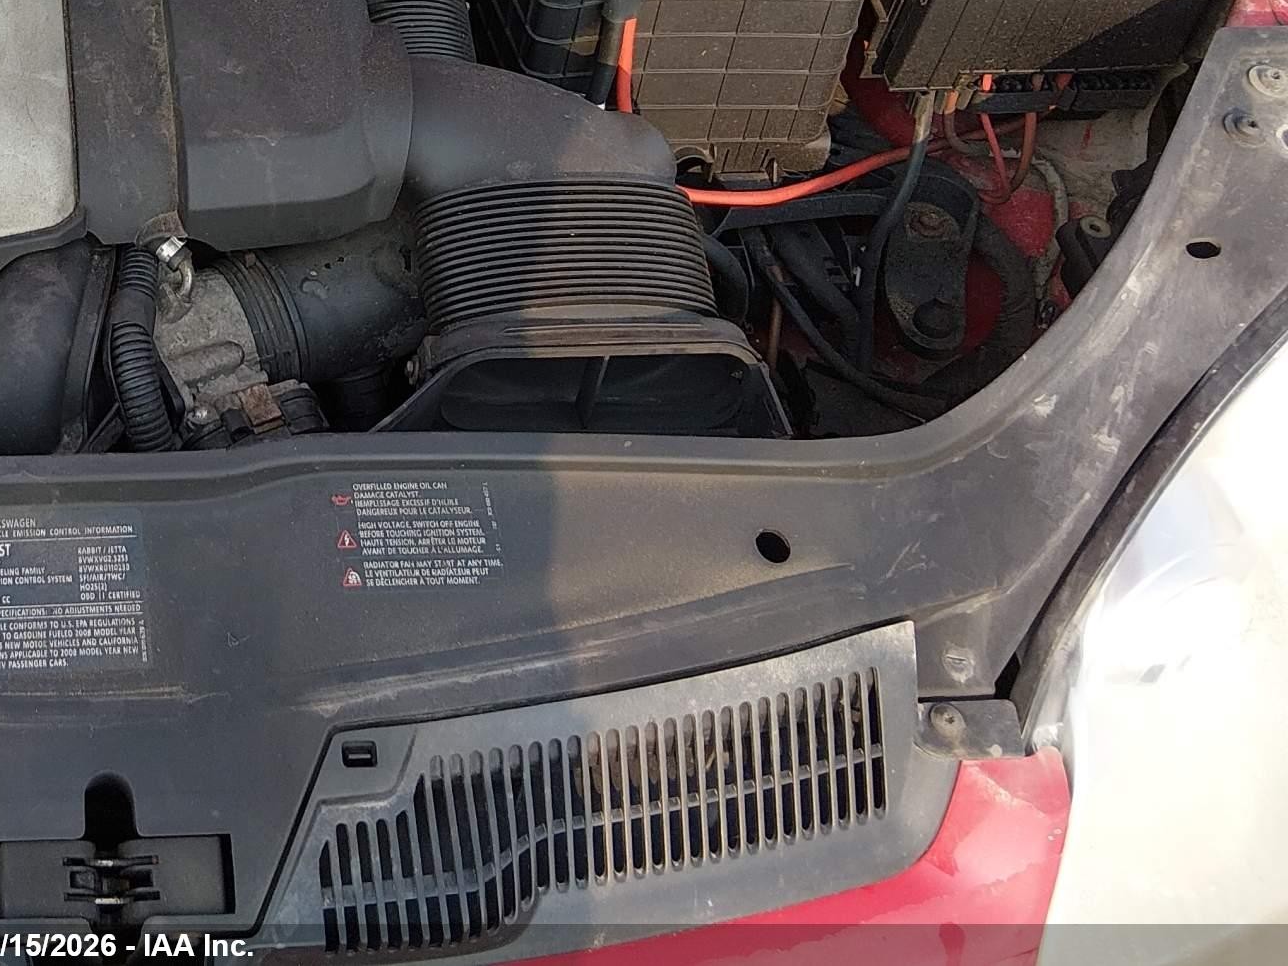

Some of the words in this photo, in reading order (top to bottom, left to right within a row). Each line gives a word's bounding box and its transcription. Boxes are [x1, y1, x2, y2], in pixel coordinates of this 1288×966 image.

[352, 482, 392, 491] OVERFILLED
[393, 482, 419, 490] ENGINE
[419, 481, 432, 490] OIL
[432, 481, 448, 490] CAN
[353, 491, 385, 499] DAMAGE
[385, 490, 422, 498] CATALYST.
[354, 499, 400, 508] REMPLISSAGE
[356, 507, 398, 516] DANGEREUX
[399, 507, 418, 515] POUR
[419, 507, 427, 515] LE
[357, 521, 376, 529] HIGH
[412, 520, 439, 528] SWITCH
[439, 520, 454, 528] OFF
[454, 520, 480, 528] ENGINE
[13, 528, 46, 537] EMISSION
[49, 527, 81, 536] CONTROL
[84, 525, 133, 534] INFORMATION
[359, 529, 385, 538] BEFORE
[386, 529, 422, 537] TOUCHING
[423, 528, 455, 537] IGNITION
[360, 538, 384, 547] HAUTE
[457, 537, 486, 545] MOTEUR
[77, 546, 101, 555] RABBIT
[107, 545, 127, 554] JETTA
[362, 547, 385, 555] AVANT
[387, 547, 397, 555] DE
[397, 546, 429, 555] TOUCHER
[363, 561, 399, 569] RADIATOR
[400, 560, 415, 568] FAN
[416, 560, 432, 568] MAY
[433, 559, 455, 567] START
[457, 559, 466, 567] AT
[467, 559, 482, 567] ANY
[483, 558, 504, 567] TIME.
[21, 566, 46, 575] FAMILY
[365, 569, 373, 577] LE
[374, 568, 420, 577] VENTILATEUR
[432, 567, 471, 576] RADIATEUR
[472, 567, 489, 575] PEUT
[14, 576, 46, 585] CONTROL
[47, 575, 73, 584] SYSTEM
[366, 578, 374, 586] SE
[425, 577, 444, 585] TOUT
[2, 595, 11, 604] CC
[80, 592, 95, 601] OBD
[108, 590, 141, 599] CERTIFIED
[52, 606, 63, 615] NO
[64, 604, 113, 614] ADJUSTMENTS
[114, 603, 141, 612] NEEDED
[9, 621, 48, 631] CONFORMS
[50, 620, 59, 629] TO
[60, 619, 74, 628] U.S.
[75, 619, 88, 628] EPA
[89, 617, 135, 627] REGULATIONS
[2, 632, 12, 640] TO
[13, 631, 47, 640] GASOLINE
[48, 629, 73, 638] FUELED
[75, 628, 92, 637] 2008
[93, 627, 118, 637] MODEL
[119, 626, 136, 635] YEAR
[4, 641, 21, 650] NEW
[23, 639, 48, 649] MOTOR
[49, 638, 80, 648] VEHICLES
[82, 637, 97, 647] AND
[98, 636, 139, 646] CALIFORNIA
[9, 649, 48, 659] APPLICABLE
[49, 649, 59, 658] TO
[60, 648, 77, 657] 2008
[78, 647, 103, 656] MODEL
[104, 646, 121, 655] YEAR
[123, 645, 139, 654] NEW
[8, 659, 47, 669] PASSENGER
[49, 658, 69, 667] CARS.
